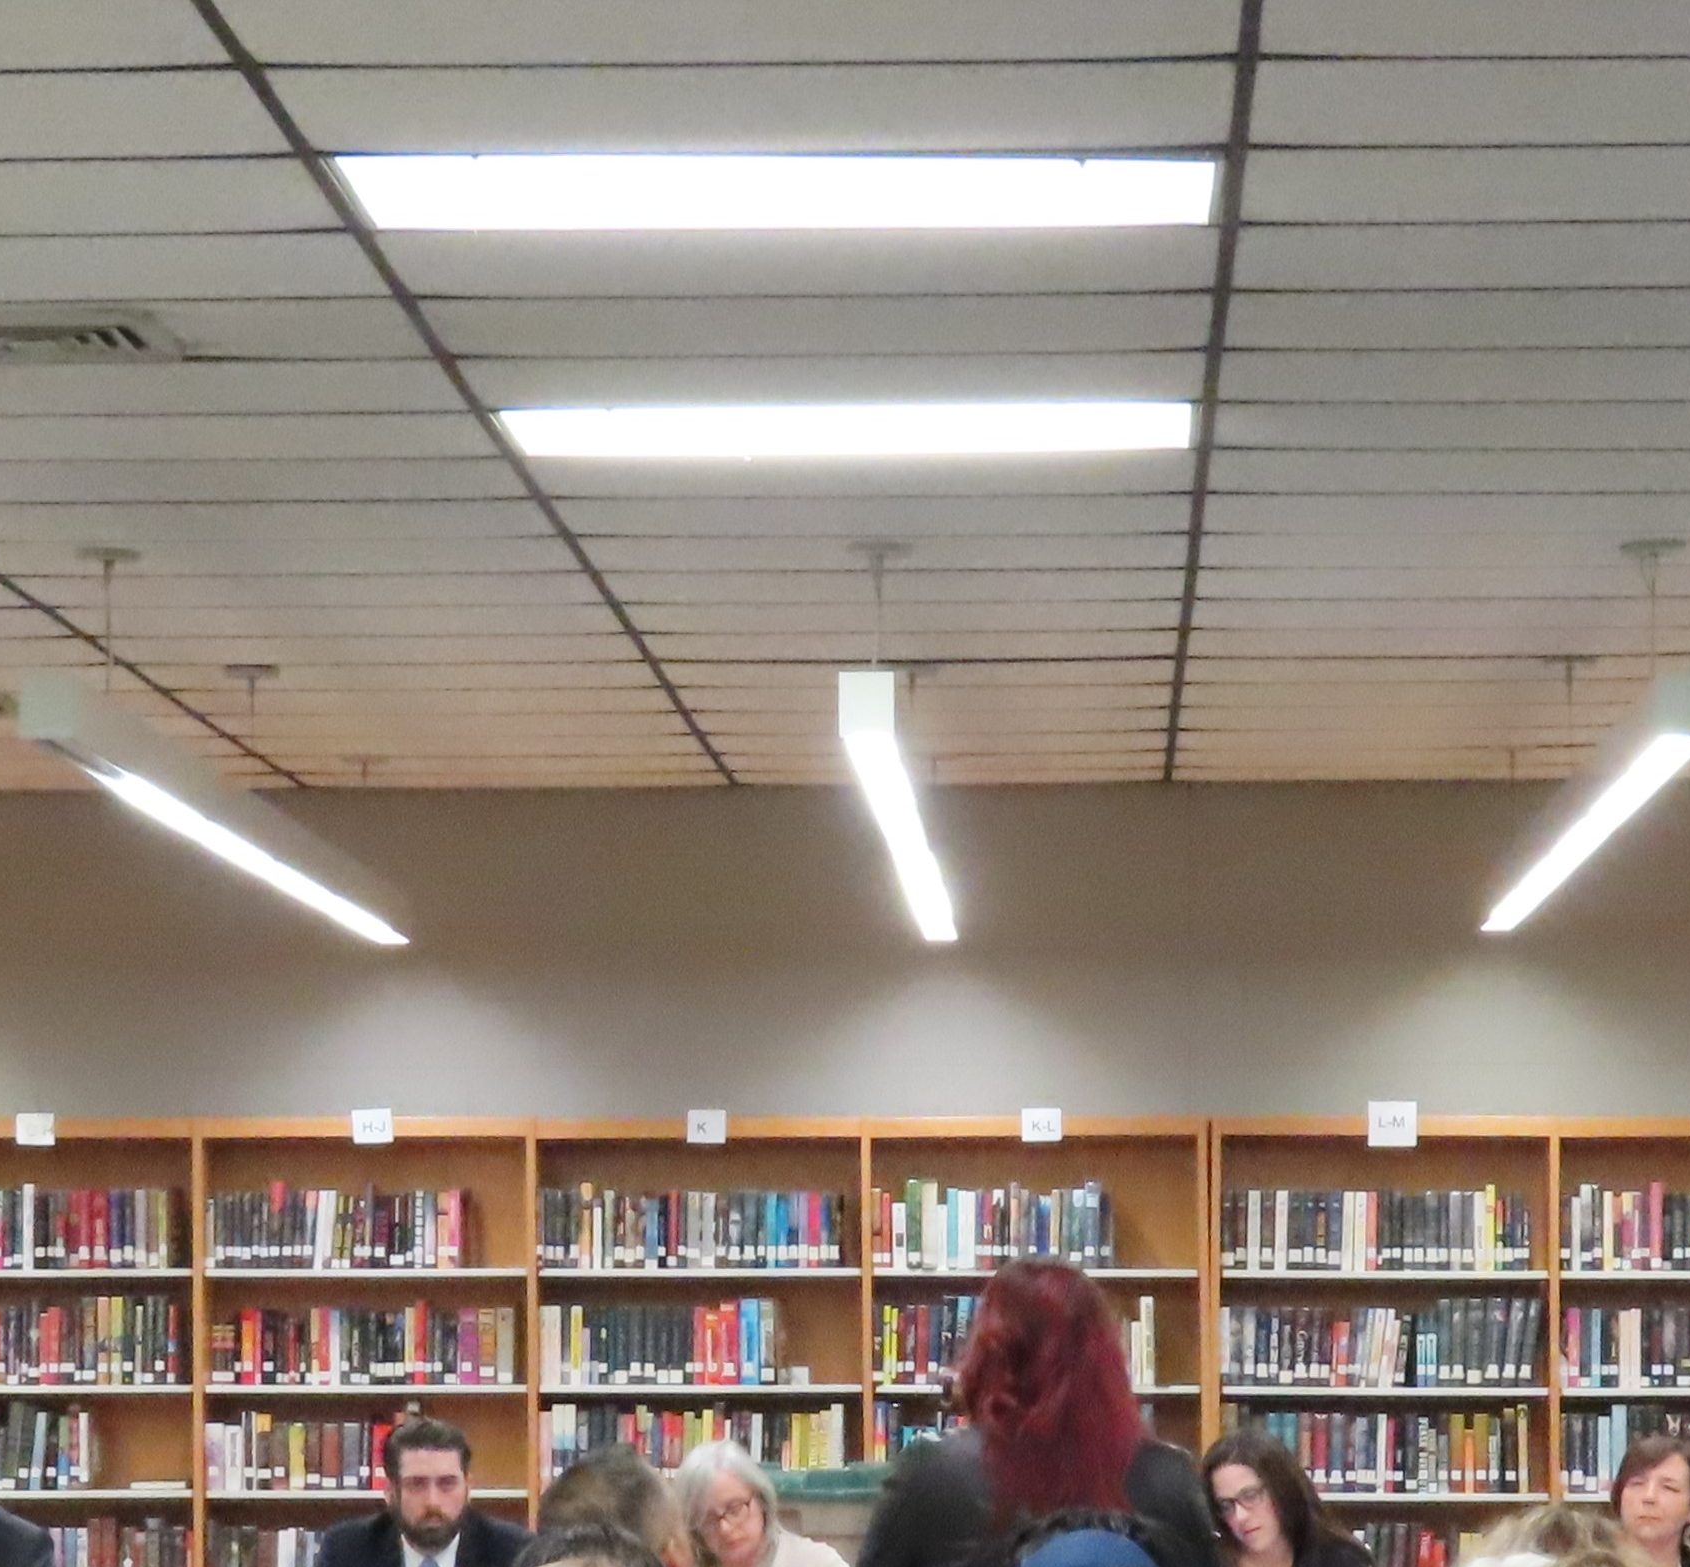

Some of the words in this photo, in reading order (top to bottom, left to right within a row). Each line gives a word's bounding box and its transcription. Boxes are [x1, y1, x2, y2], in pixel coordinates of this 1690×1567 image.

[362, 1121, 386, 1133] H-J
[696, 1122, 707, 1134] K
[1031, 1120, 1055, 1133] K-L
[1378, 1116, 1406, 1128] L-M
